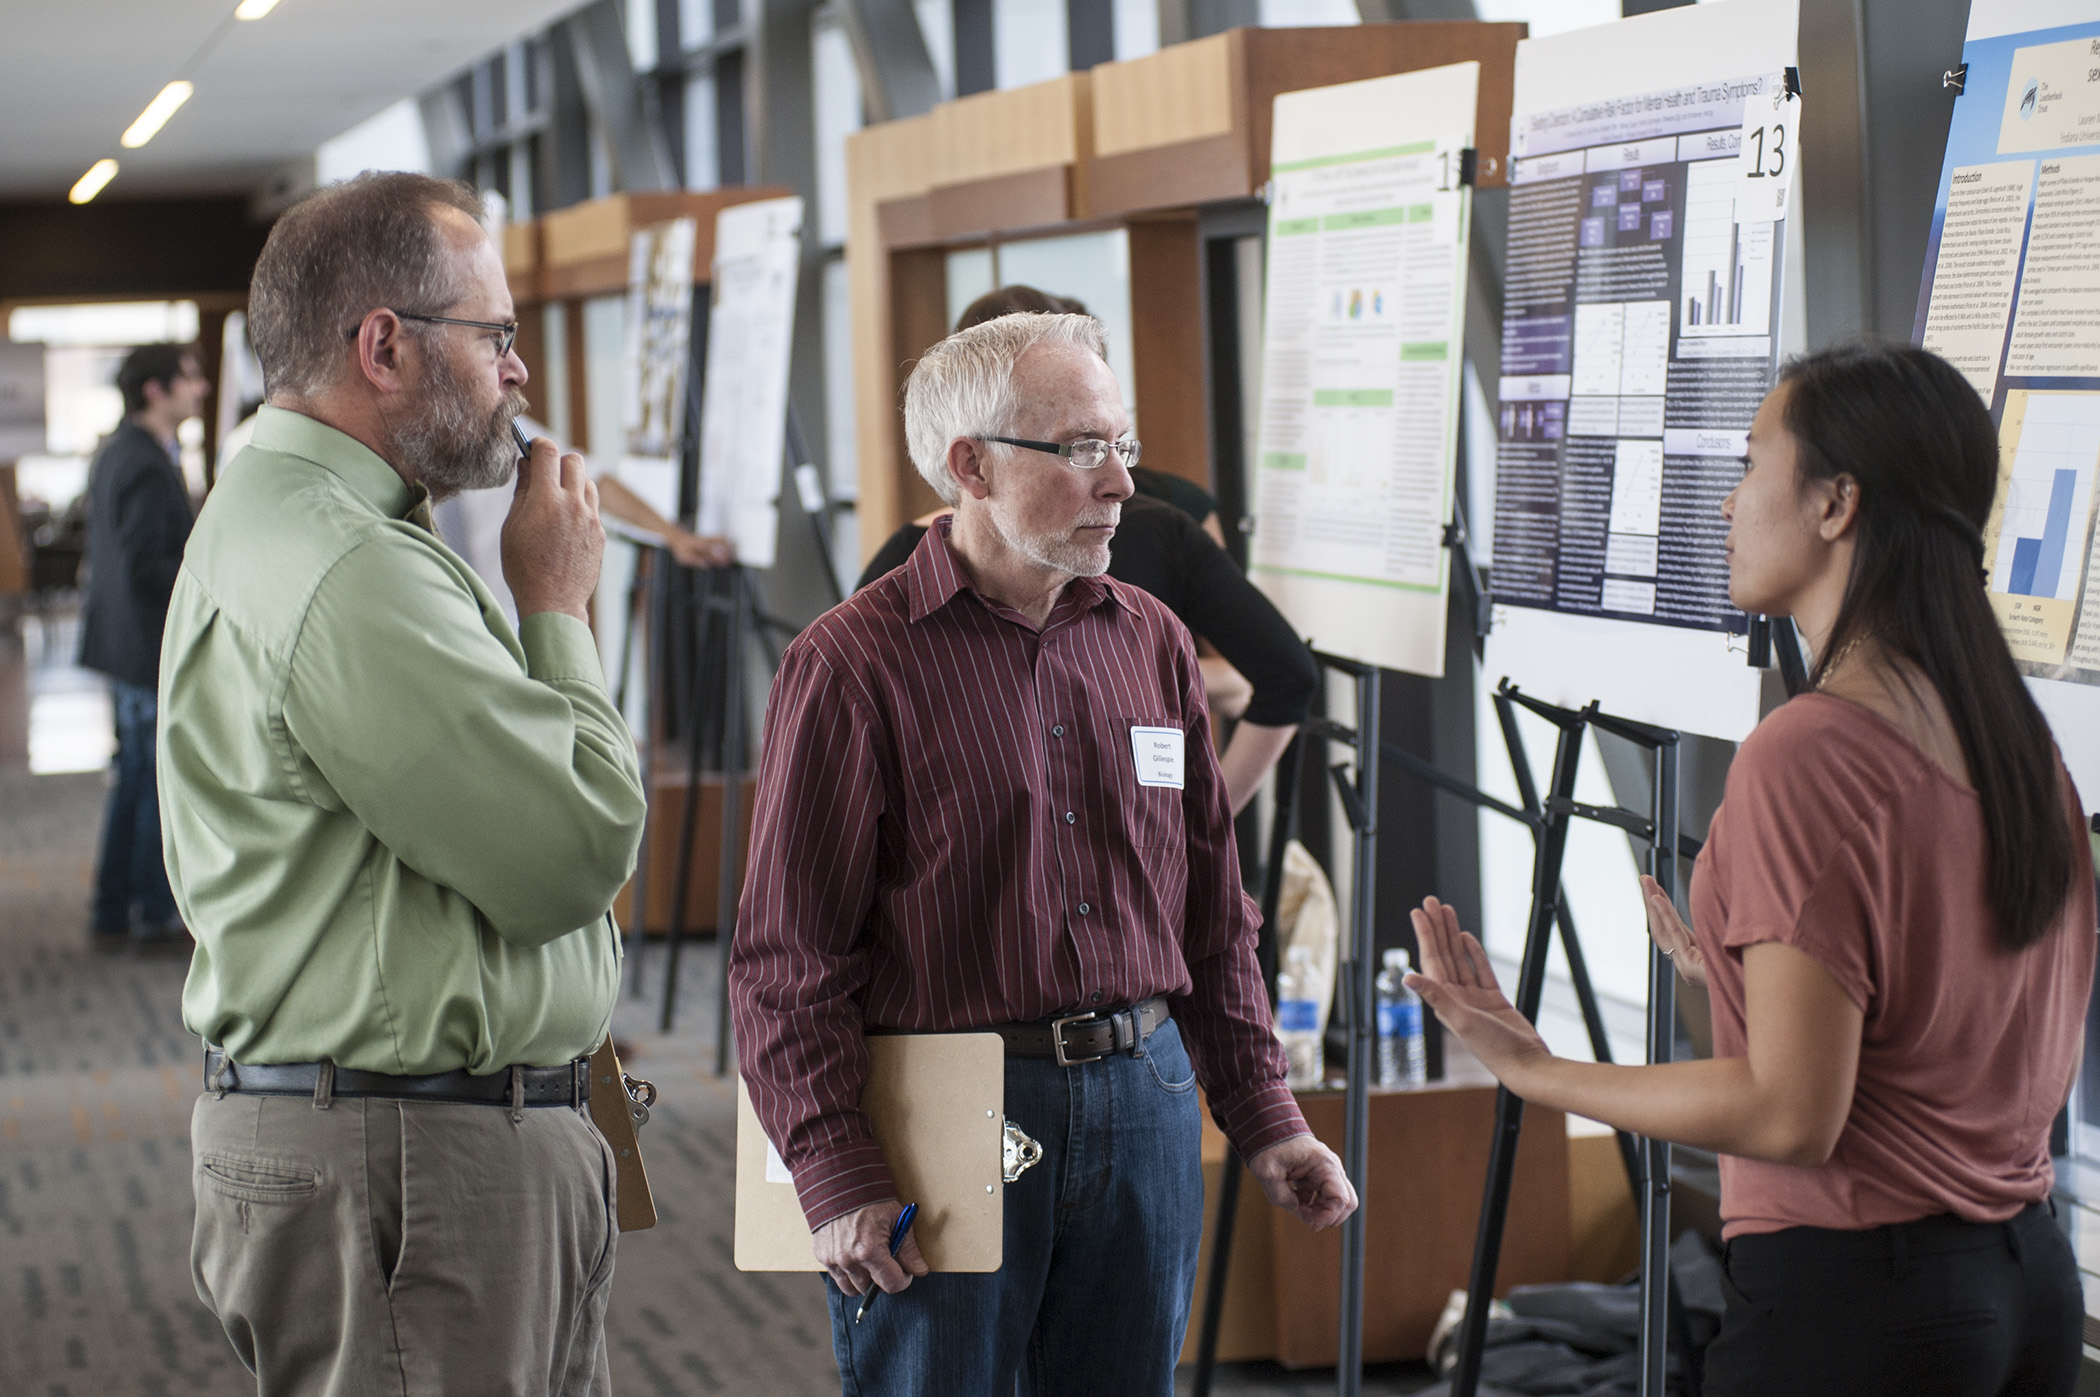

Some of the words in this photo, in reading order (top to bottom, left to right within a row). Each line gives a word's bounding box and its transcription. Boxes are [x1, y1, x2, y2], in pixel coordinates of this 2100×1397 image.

[1697, 85, 1722, 104] Trauma
[1723, 77, 1763, 104] Symptoms?
[1747, 123, 1785, 178] 13
[1952, 171, 1982, 185] Introduction
[2041, 164, 2061, 175] Methods
